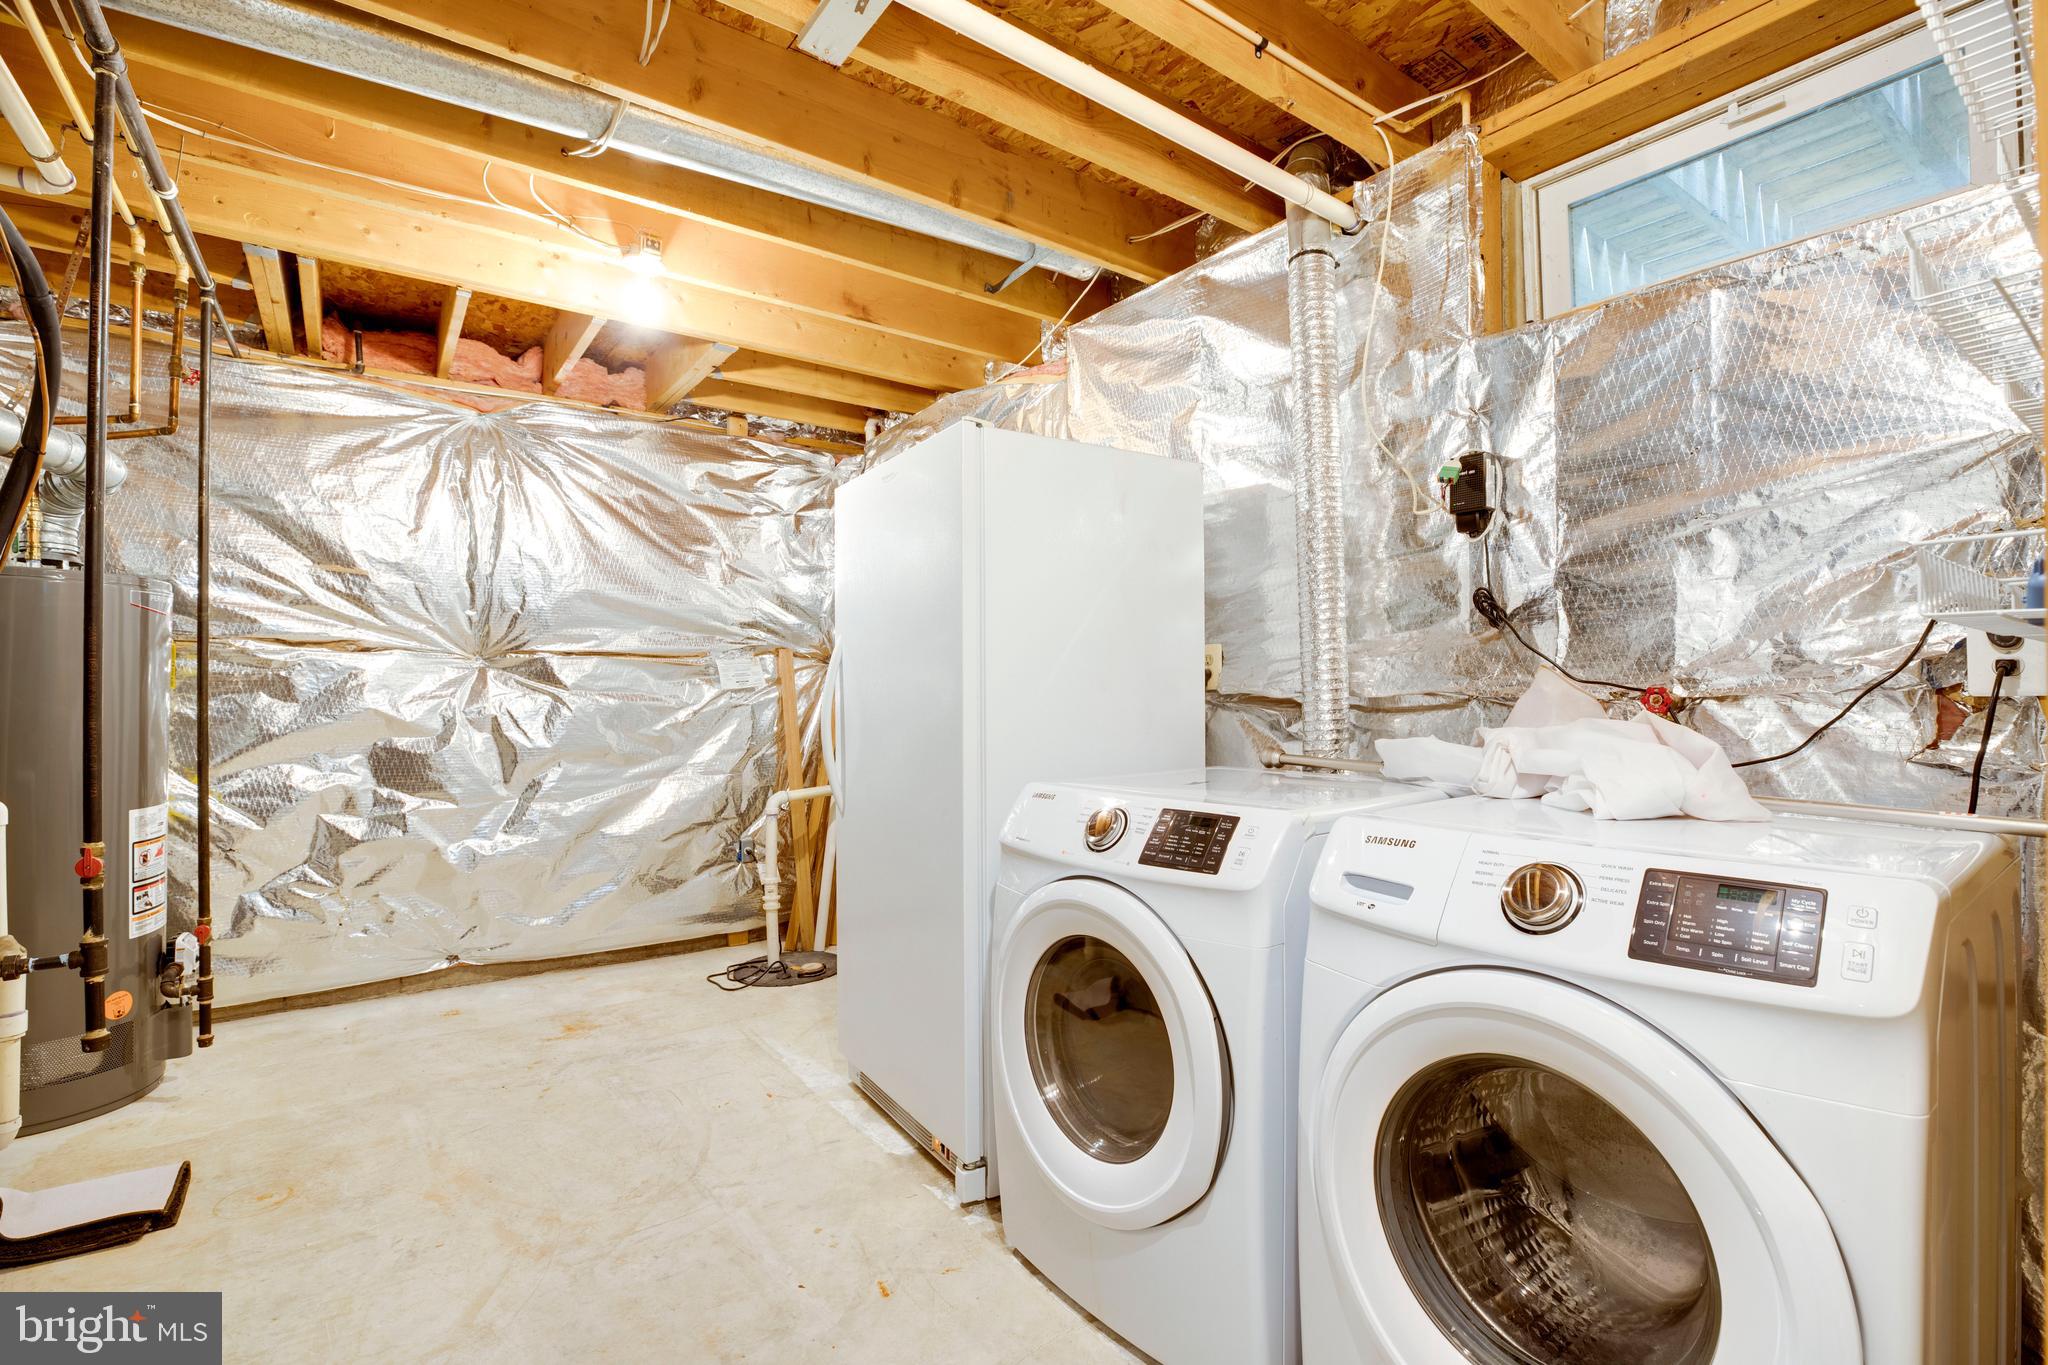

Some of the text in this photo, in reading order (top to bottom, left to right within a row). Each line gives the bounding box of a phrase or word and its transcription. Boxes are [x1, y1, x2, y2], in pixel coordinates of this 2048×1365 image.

[1365, 835, 1417, 849] SAMSUNG
[1676, 945, 1691, 953] Temp.
[1711, 951, 1724, 959] Spin
[1752, 958, 1769, 966] Level
[1779, 961, 1811, 972] Smart Care
